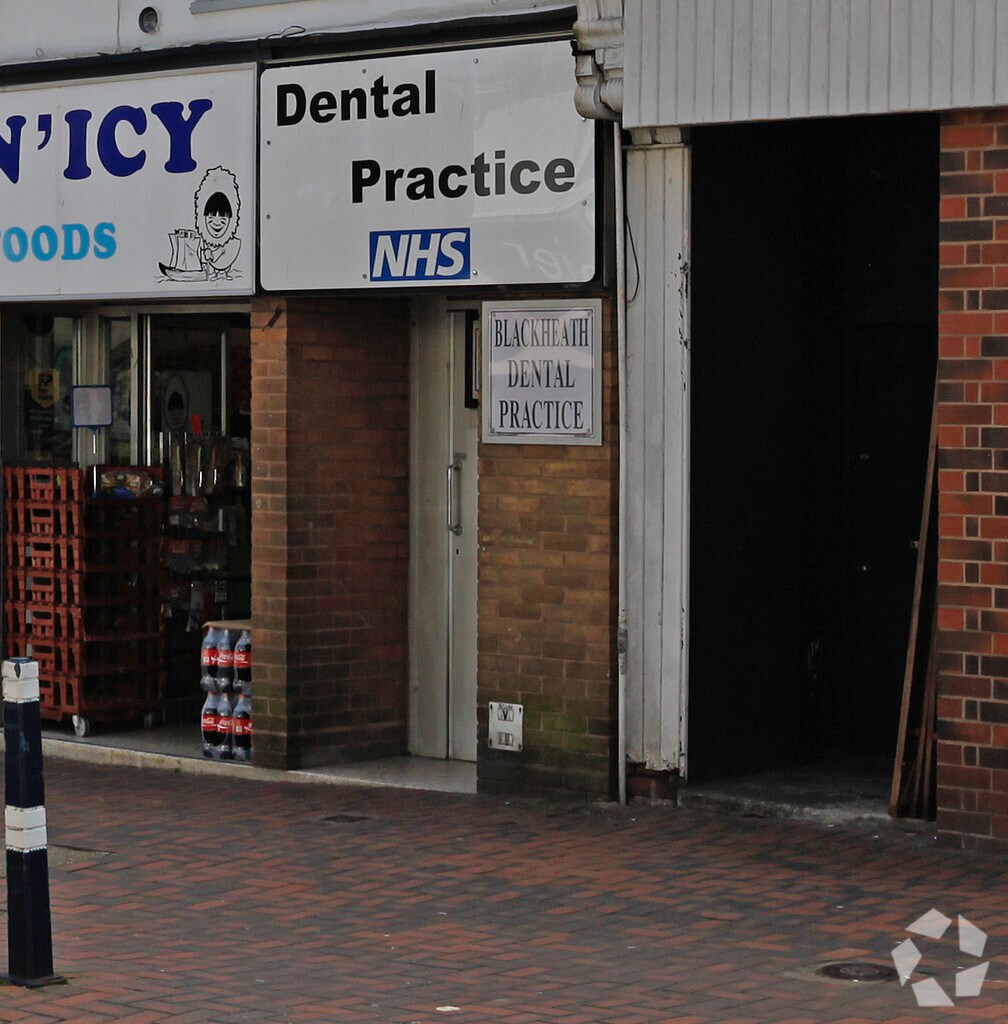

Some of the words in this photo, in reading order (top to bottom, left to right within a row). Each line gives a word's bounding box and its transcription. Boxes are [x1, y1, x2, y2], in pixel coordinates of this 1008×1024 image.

[276, 70, 437, 127] Dental
[63, 98, 214, 181] ICY
[351, 150, 576, 204] Practice
[371, 231, 468, 278] NHS
[494, 317, 589, 347] BLACKHEATH
[507, 359, 576, 388] DENTAL
[498, 400, 584, 429] PRACTICE
